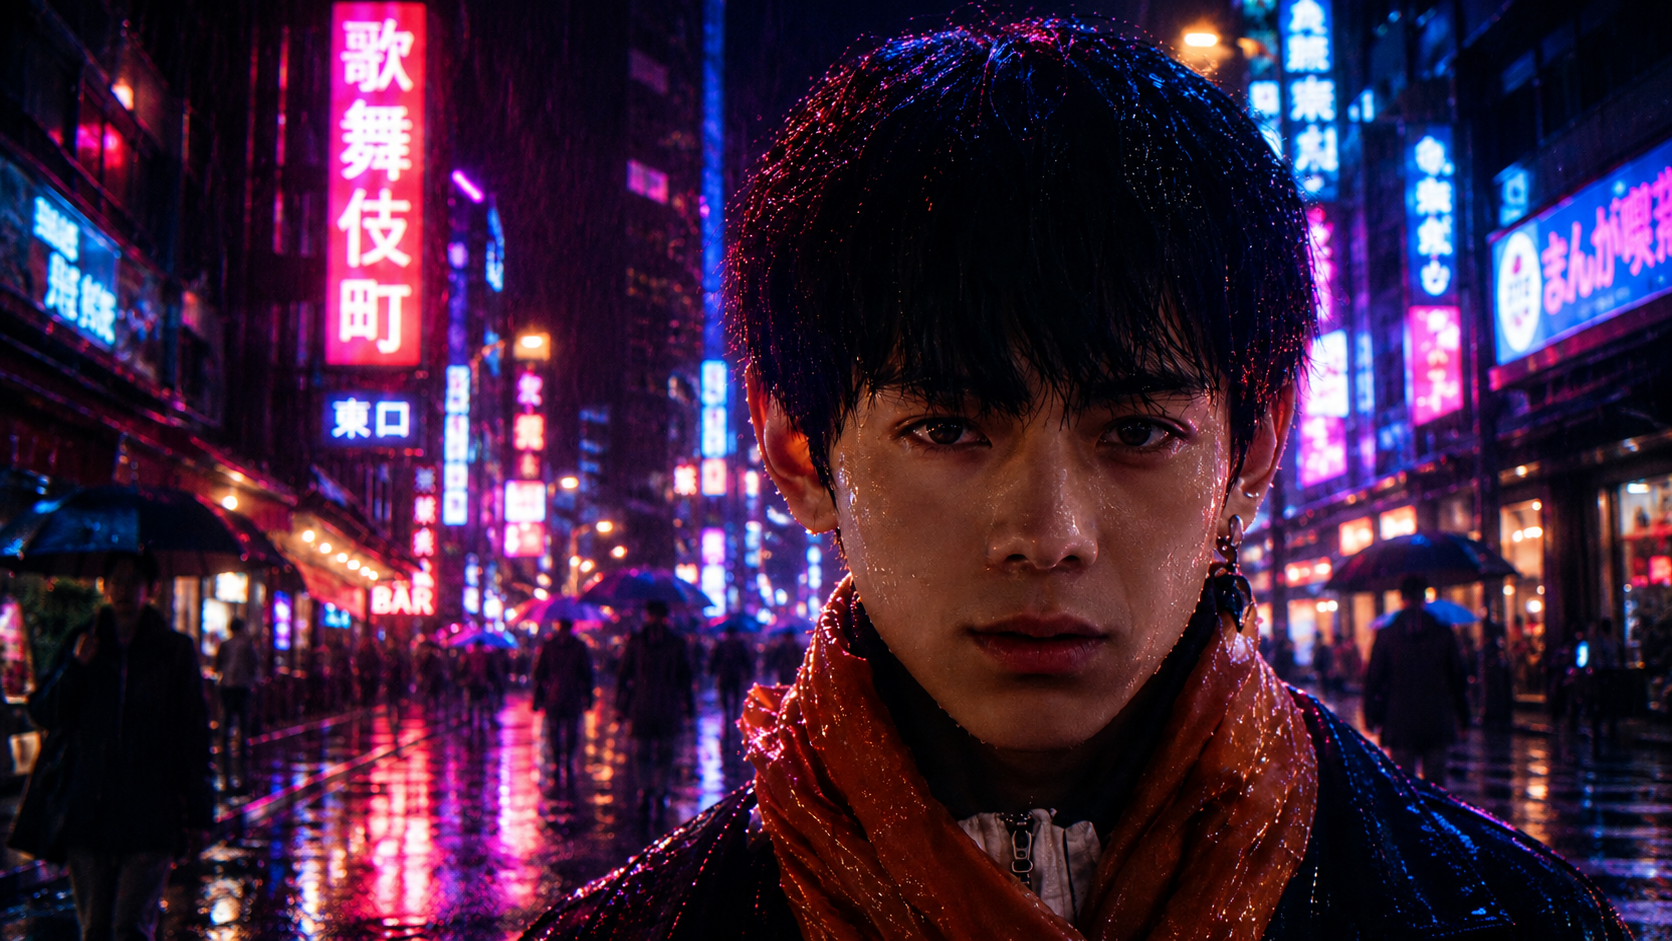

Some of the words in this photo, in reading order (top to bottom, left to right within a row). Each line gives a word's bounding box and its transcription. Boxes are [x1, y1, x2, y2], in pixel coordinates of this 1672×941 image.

[337, 18, 414, 355] 歌舞伎町
[331, 397, 411, 439] 東口
[371, 584, 435, 616] BAR
